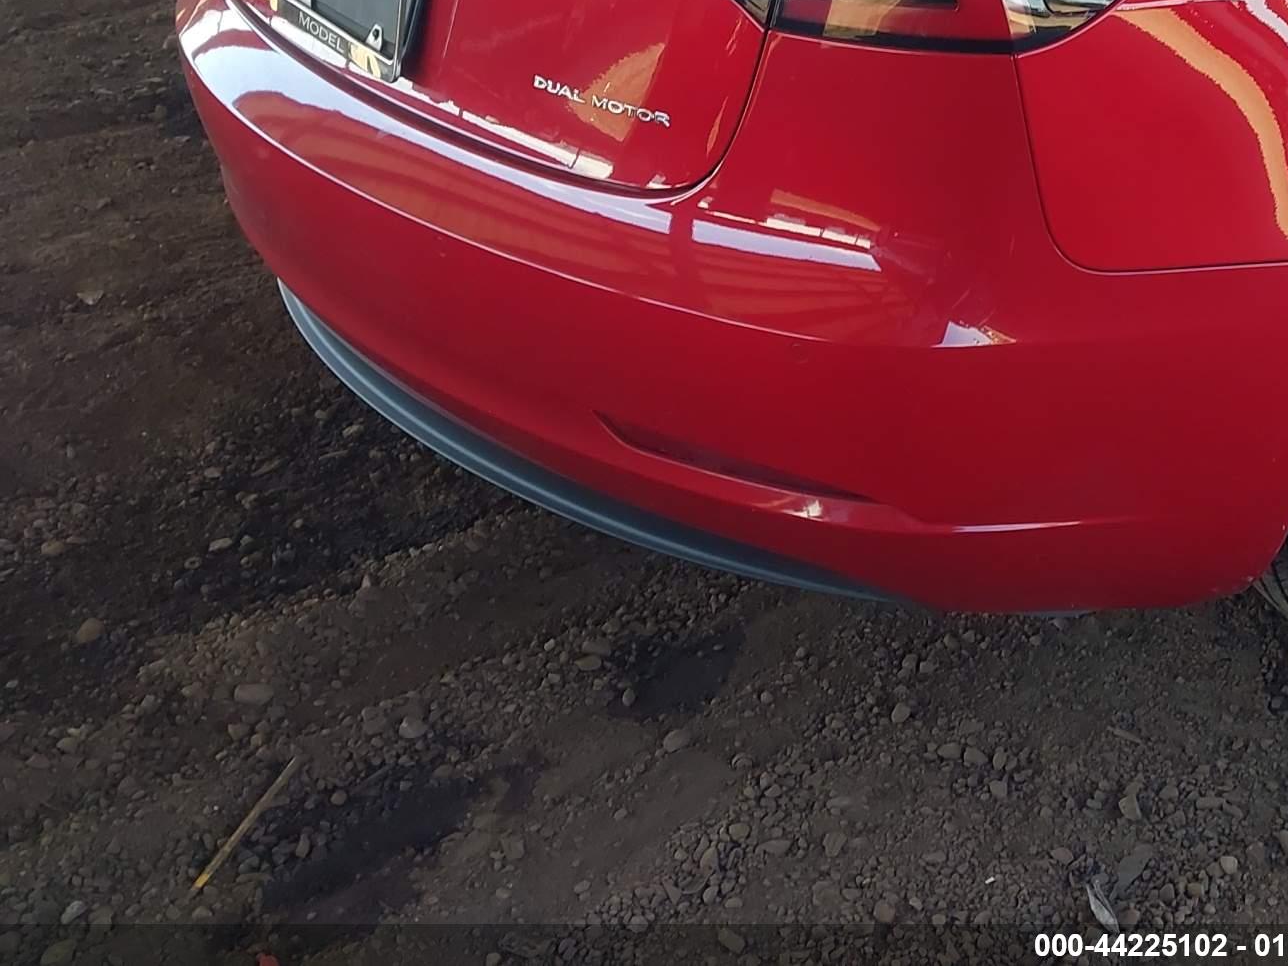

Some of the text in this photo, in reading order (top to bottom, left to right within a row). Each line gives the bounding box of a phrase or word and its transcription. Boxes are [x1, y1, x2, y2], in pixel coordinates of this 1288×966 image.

[299, 11, 346, 54] MODEL
[532, 74, 671, 128] DUAL MOTOR
